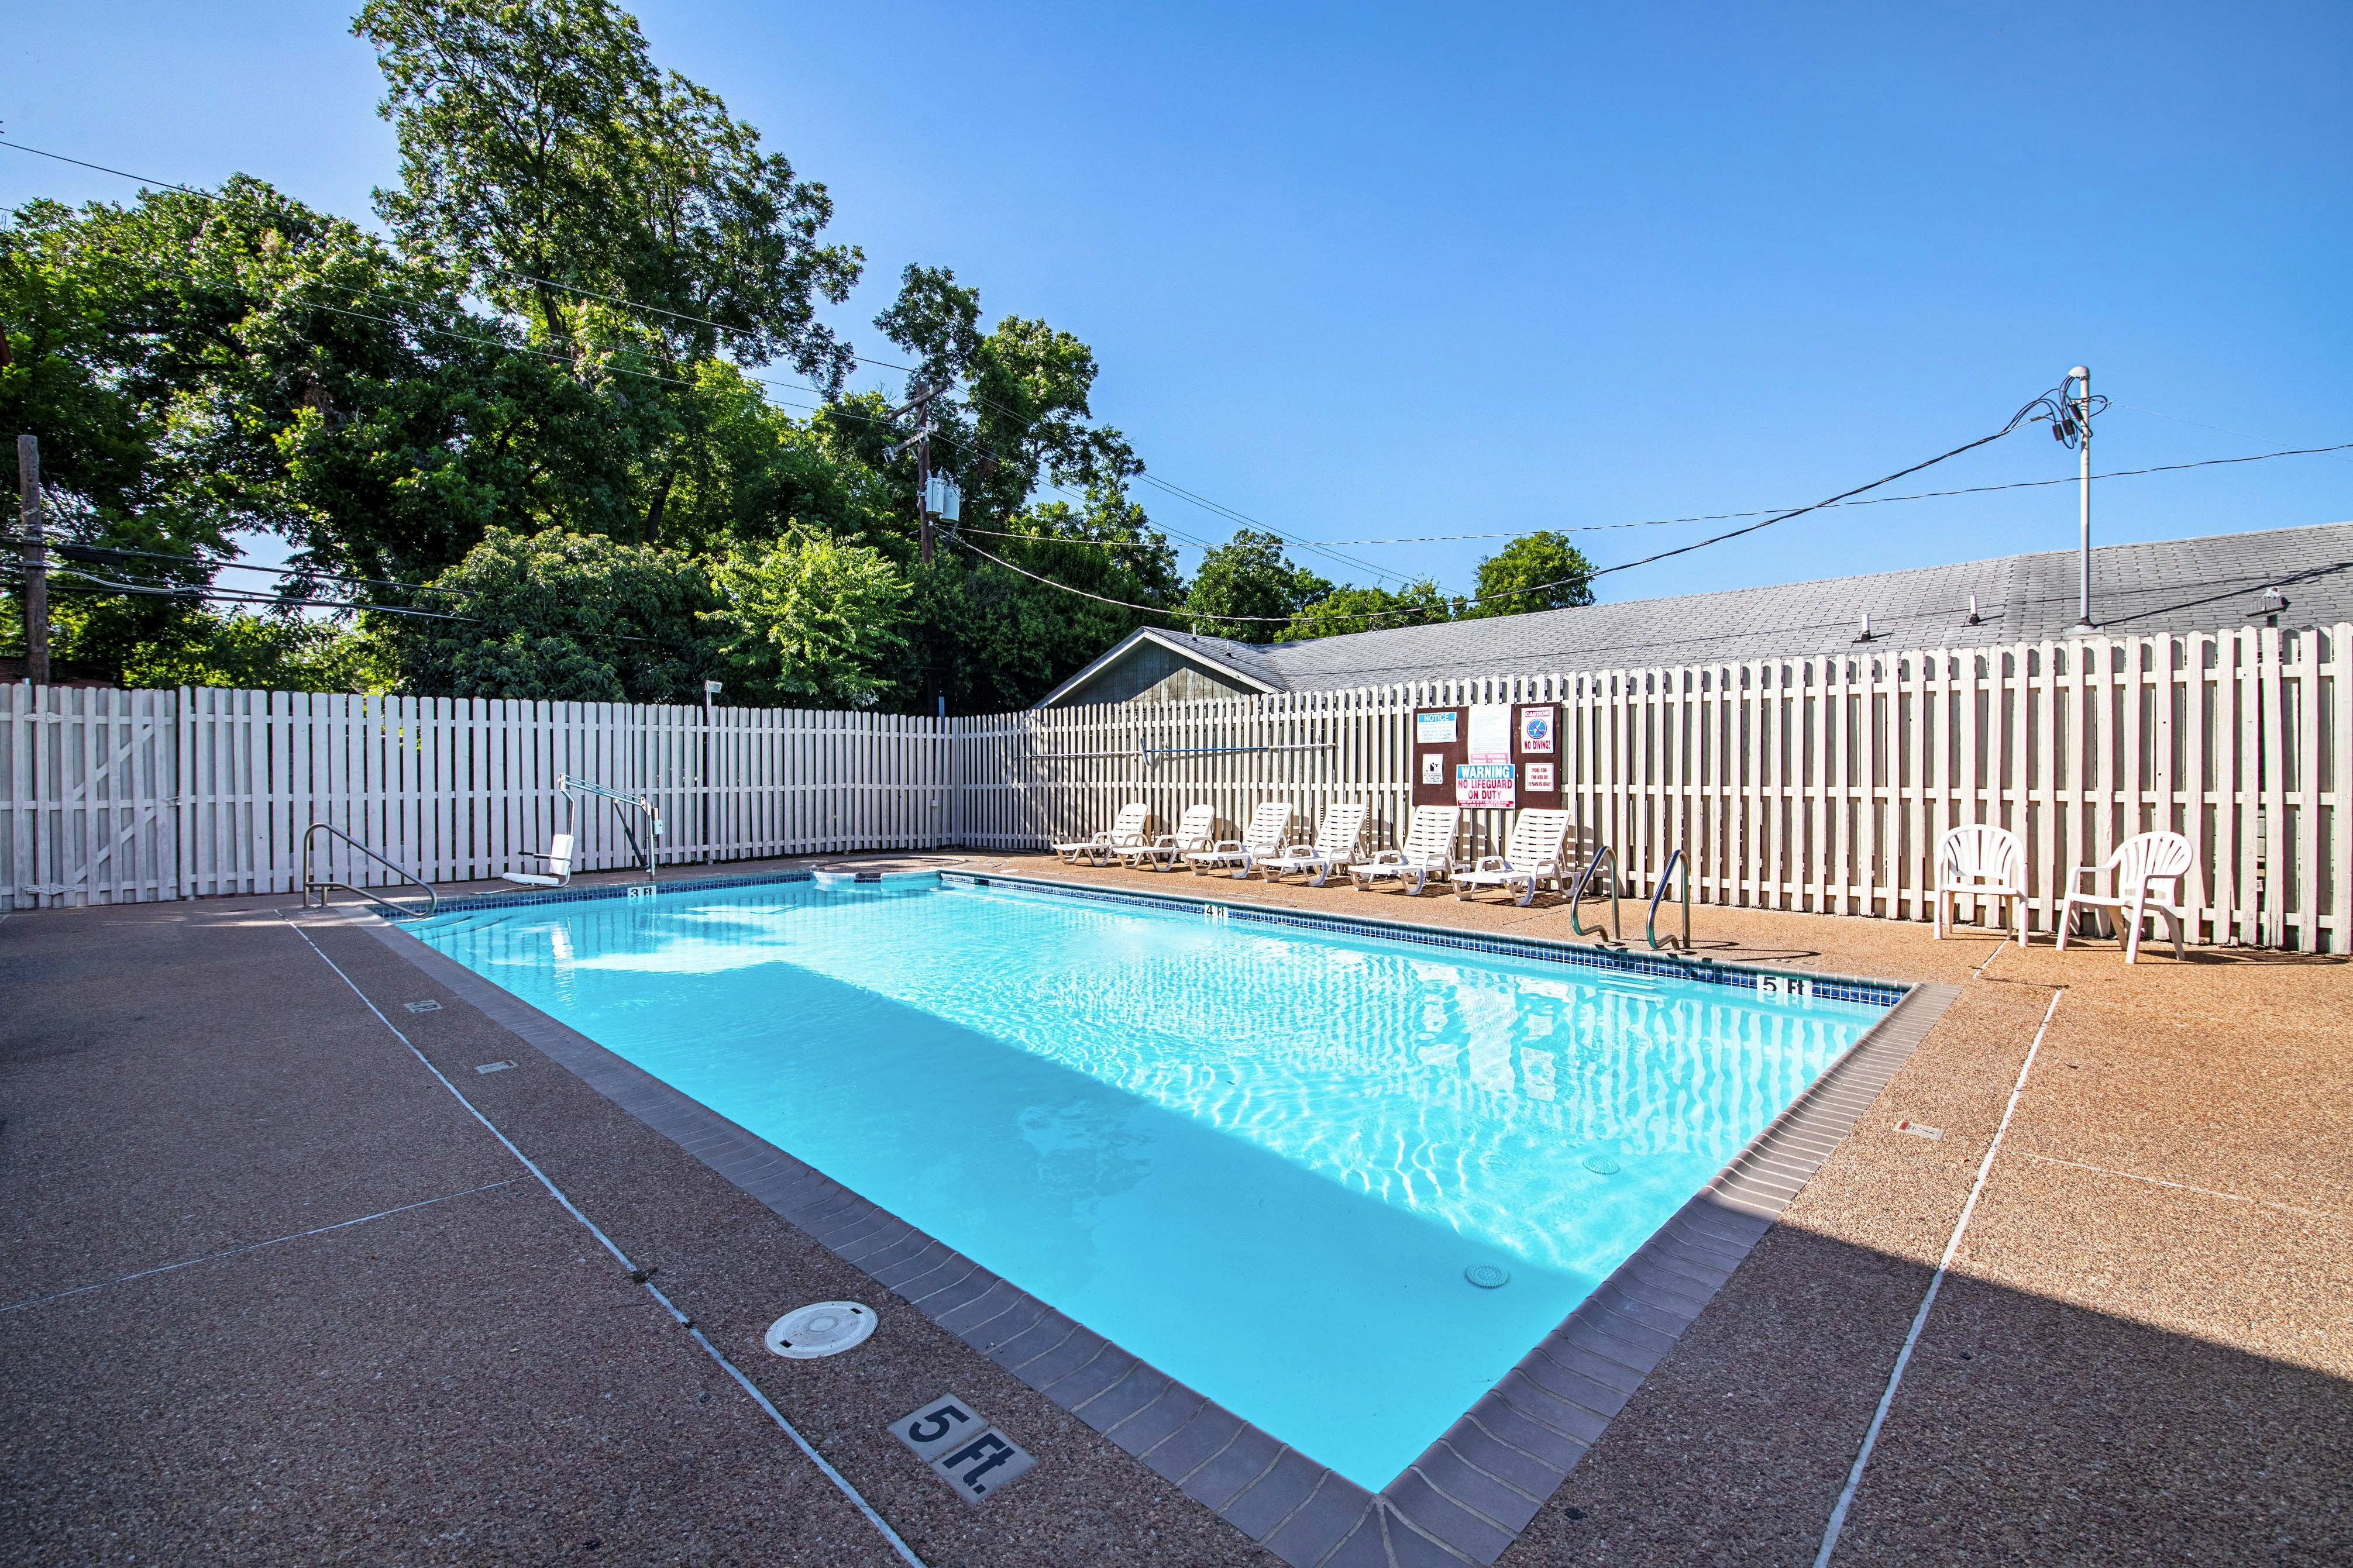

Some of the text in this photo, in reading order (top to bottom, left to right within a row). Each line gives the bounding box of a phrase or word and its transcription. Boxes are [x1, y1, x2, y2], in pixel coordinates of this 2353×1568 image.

[1424, 714, 1449, 722] NOTICE
[1525, 740, 1550, 750] NO DIVING!
[1461, 766, 1510, 778] WARNING
[1458, 779, 1512, 788] NO LIFEGUARD
[1468, 790, 1501, 799] ON DUTY
[630, 887, 652, 897] 3 Ft
[1206, 905, 1224, 916] 4 Ft
[1763, 976, 1804, 995] 5 Ft
[909, 1404, 1016, 1495] 5 Ft.
